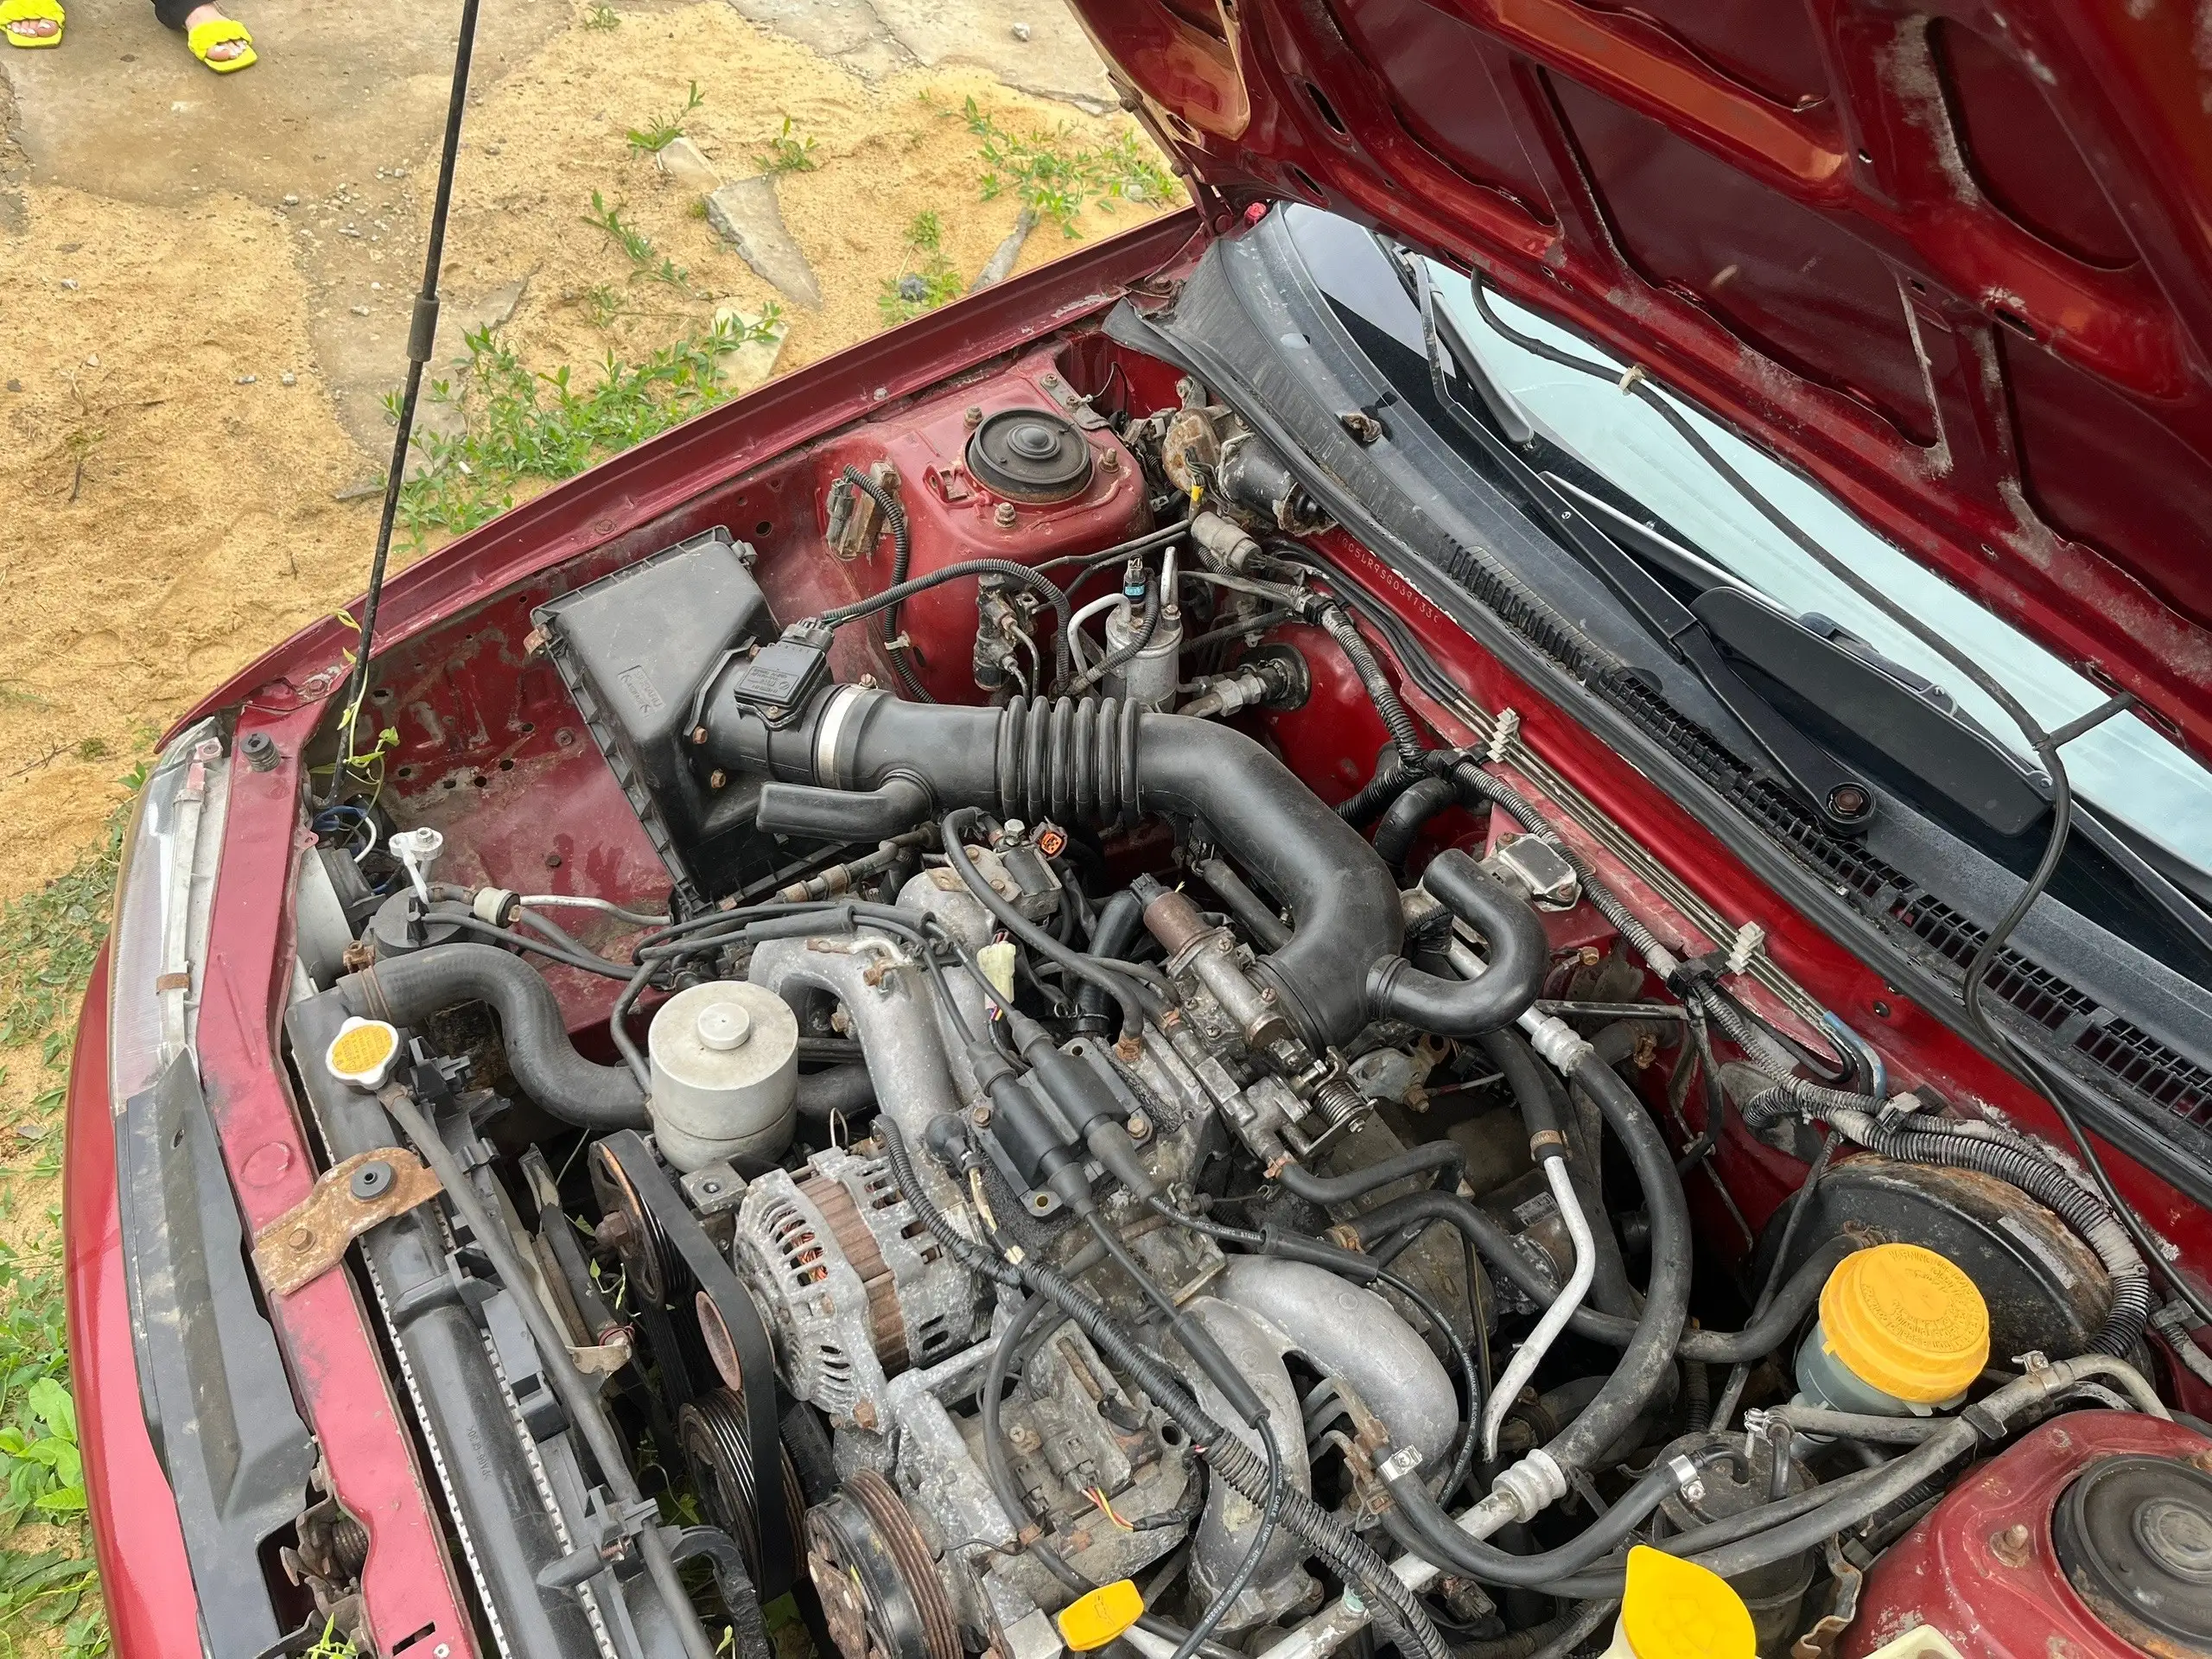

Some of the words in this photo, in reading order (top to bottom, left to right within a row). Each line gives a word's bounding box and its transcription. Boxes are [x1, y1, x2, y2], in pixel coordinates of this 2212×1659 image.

[1153, 1196, 1170, 1211] CABLE
[1174, 1211, 1190, 1221] TEMP
[1452, 1334, 1464, 1349] HIGH
[1463, 1352, 1478, 1396] PERFORMANCE
[1469, 1402, 1478, 1429] SILICONE
[1463, 1434, 1472, 1453] CABLE
[1454, 1459, 1465, 1474] TEMP
[1270, 1495, 1281, 1517] CABLE
[1262, 1523, 1272, 1541] TEMP
[1248, 1548, 1260, 1566] -40°C
[1227, 1575, 1243, 1597] +220°C
